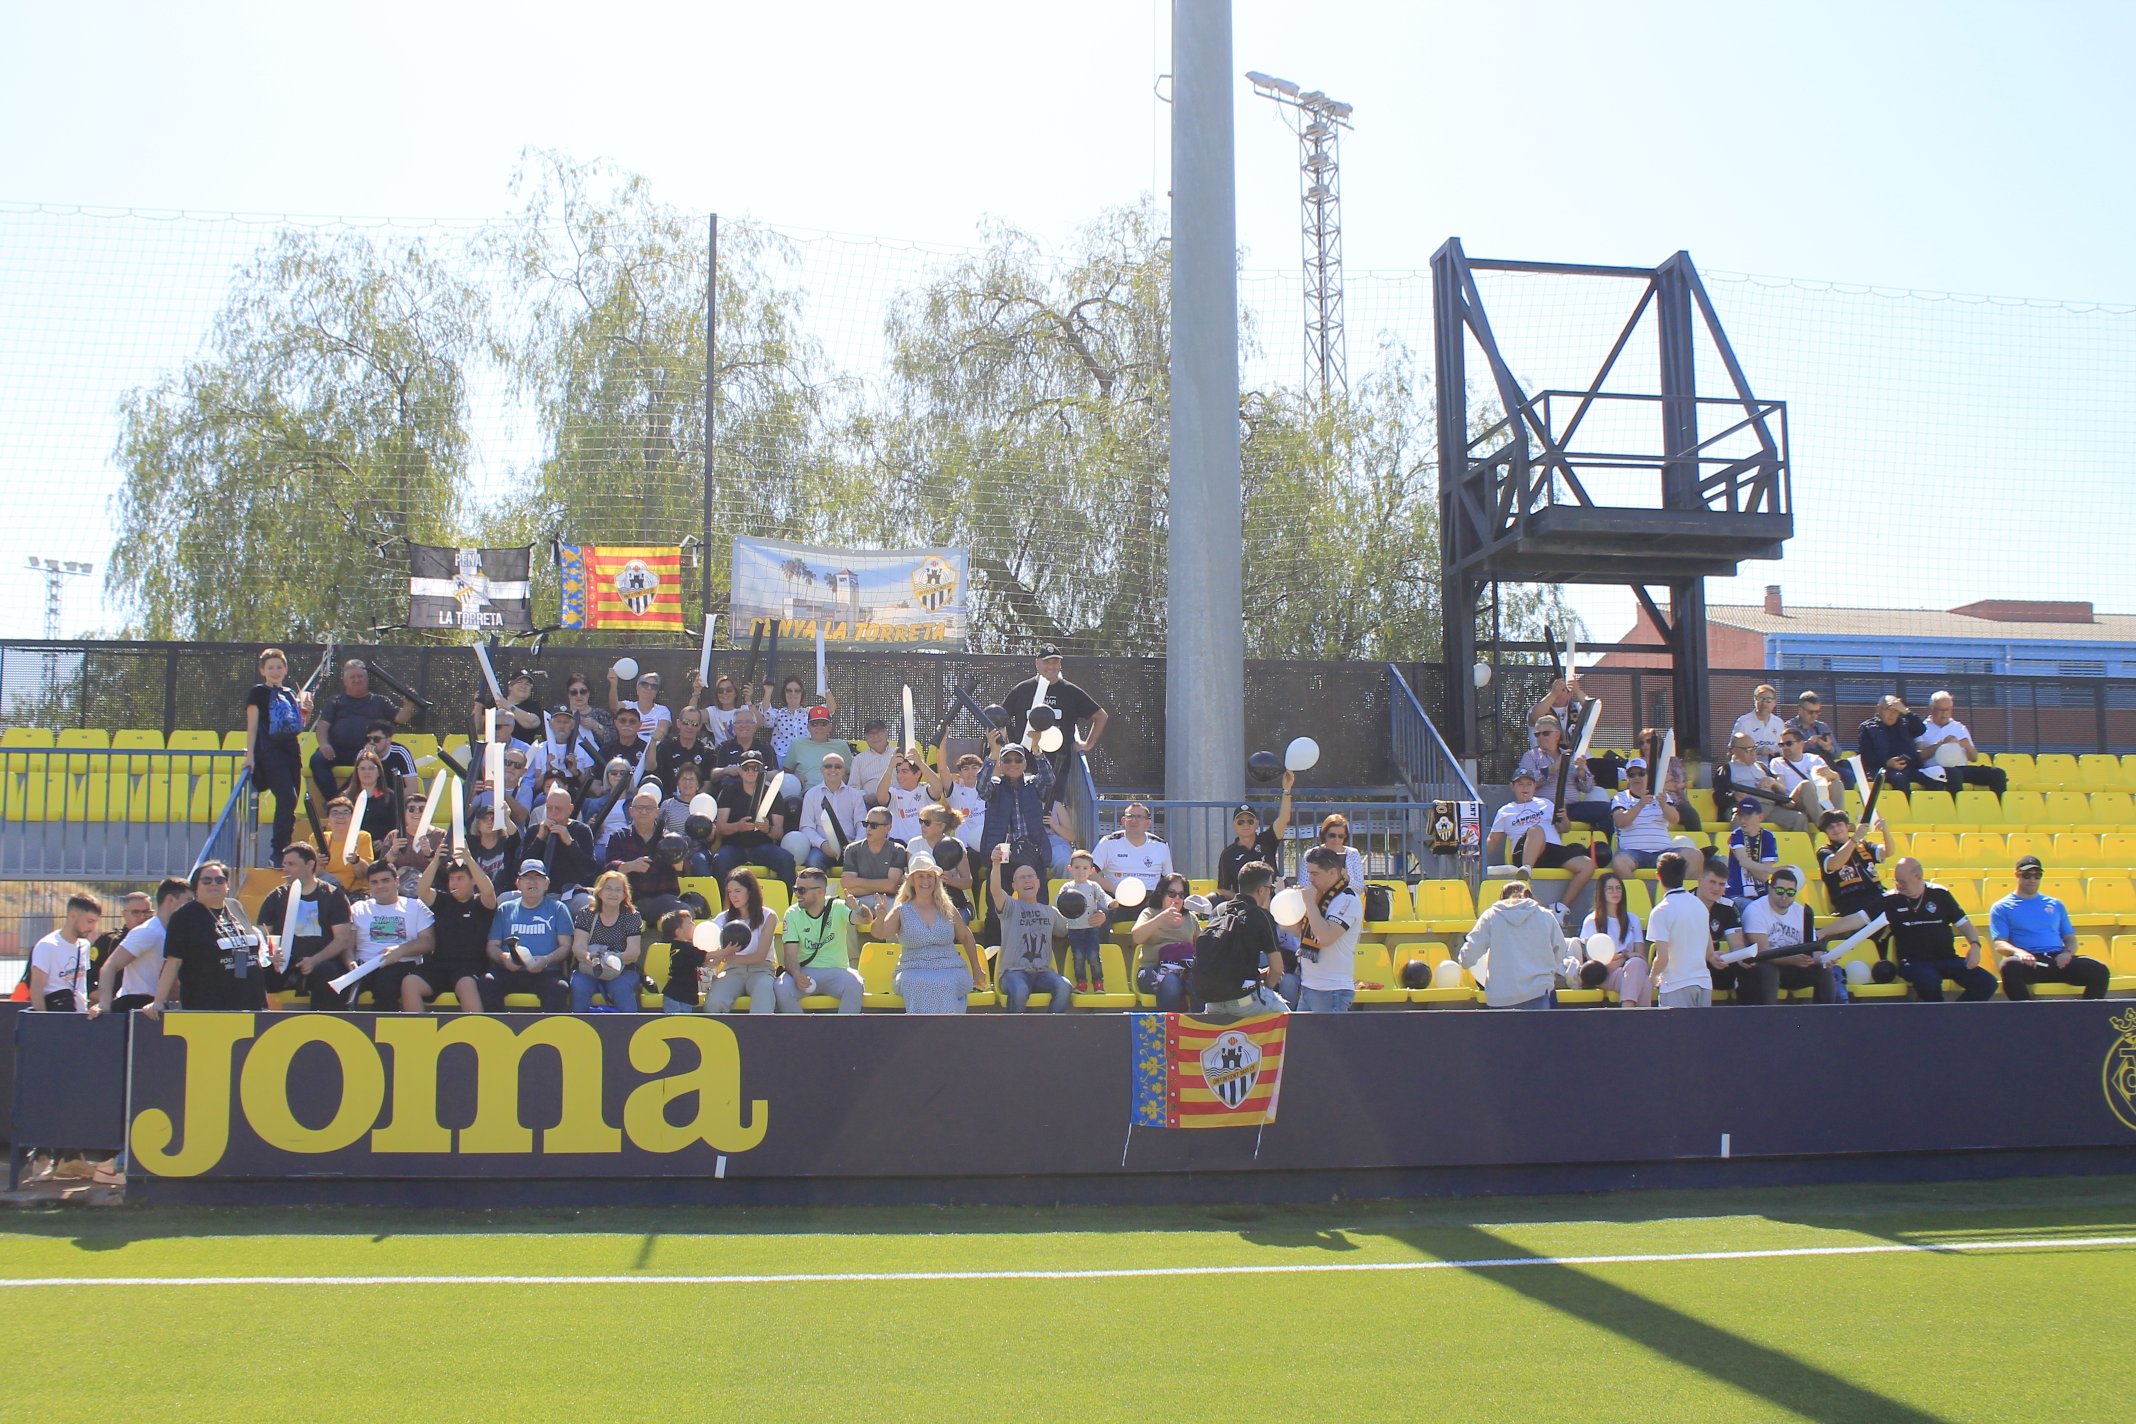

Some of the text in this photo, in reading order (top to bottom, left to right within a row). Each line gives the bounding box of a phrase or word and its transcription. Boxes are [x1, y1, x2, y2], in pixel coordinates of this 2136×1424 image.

[438, 610, 504, 627] LA TORRETA
[823, 620, 849, 642] LA
[854, 620, 946, 643] TORRETA
[511, 923, 546, 935] PUMA
